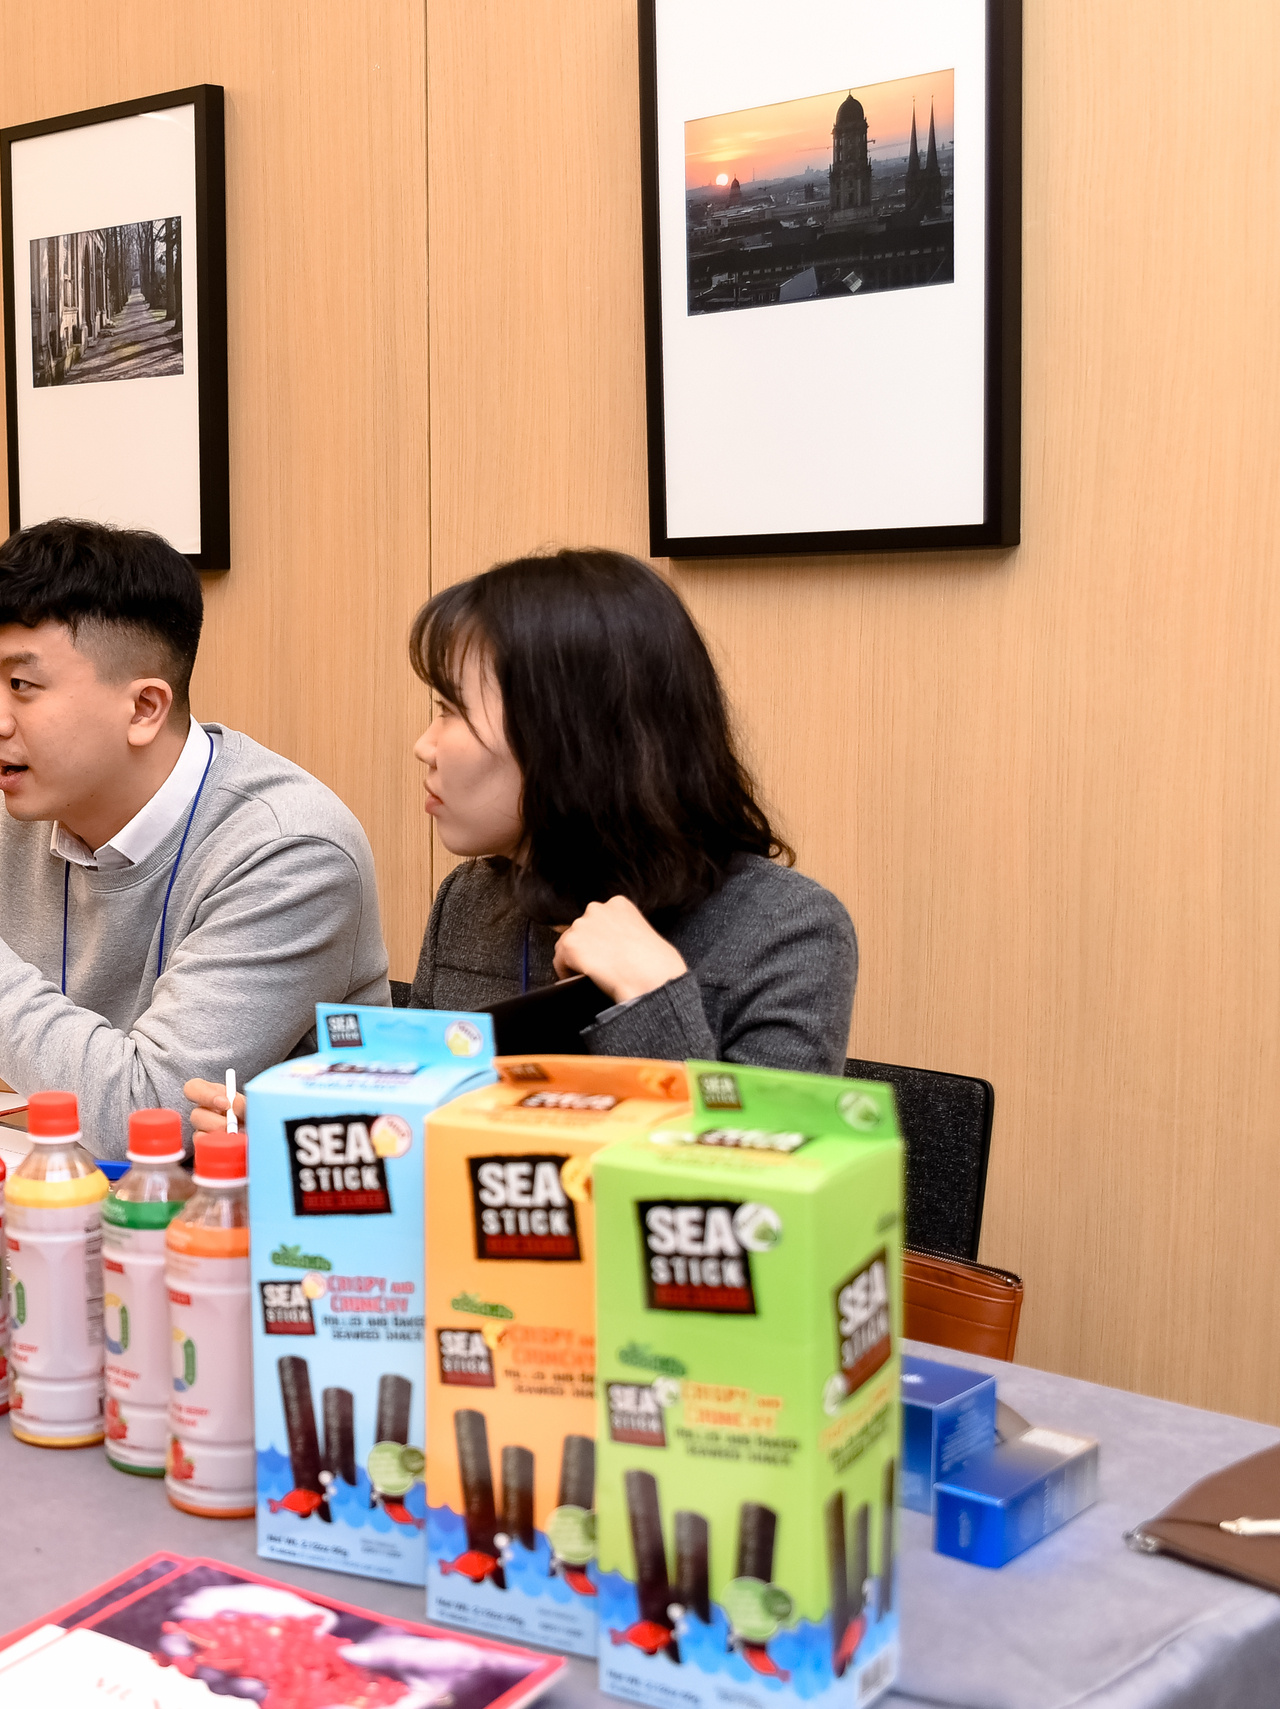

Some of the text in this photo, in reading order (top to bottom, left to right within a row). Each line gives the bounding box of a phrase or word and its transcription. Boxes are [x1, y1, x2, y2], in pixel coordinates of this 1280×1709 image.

[327, 1014, 357, 1032] SEA
[294, 1122, 377, 1166] SEA
[299, 1166, 380, 1192] STICK
[477, 1161, 567, 1208] SEA
[481, 1208, 570, 1236] STICK
[645, 1205, 742, 1256] SEA
[650, 1255, 746, 1288] STICK
[263, 1284, 308, 1307] SEA
[440, 1331, 488, 1358] SEA
